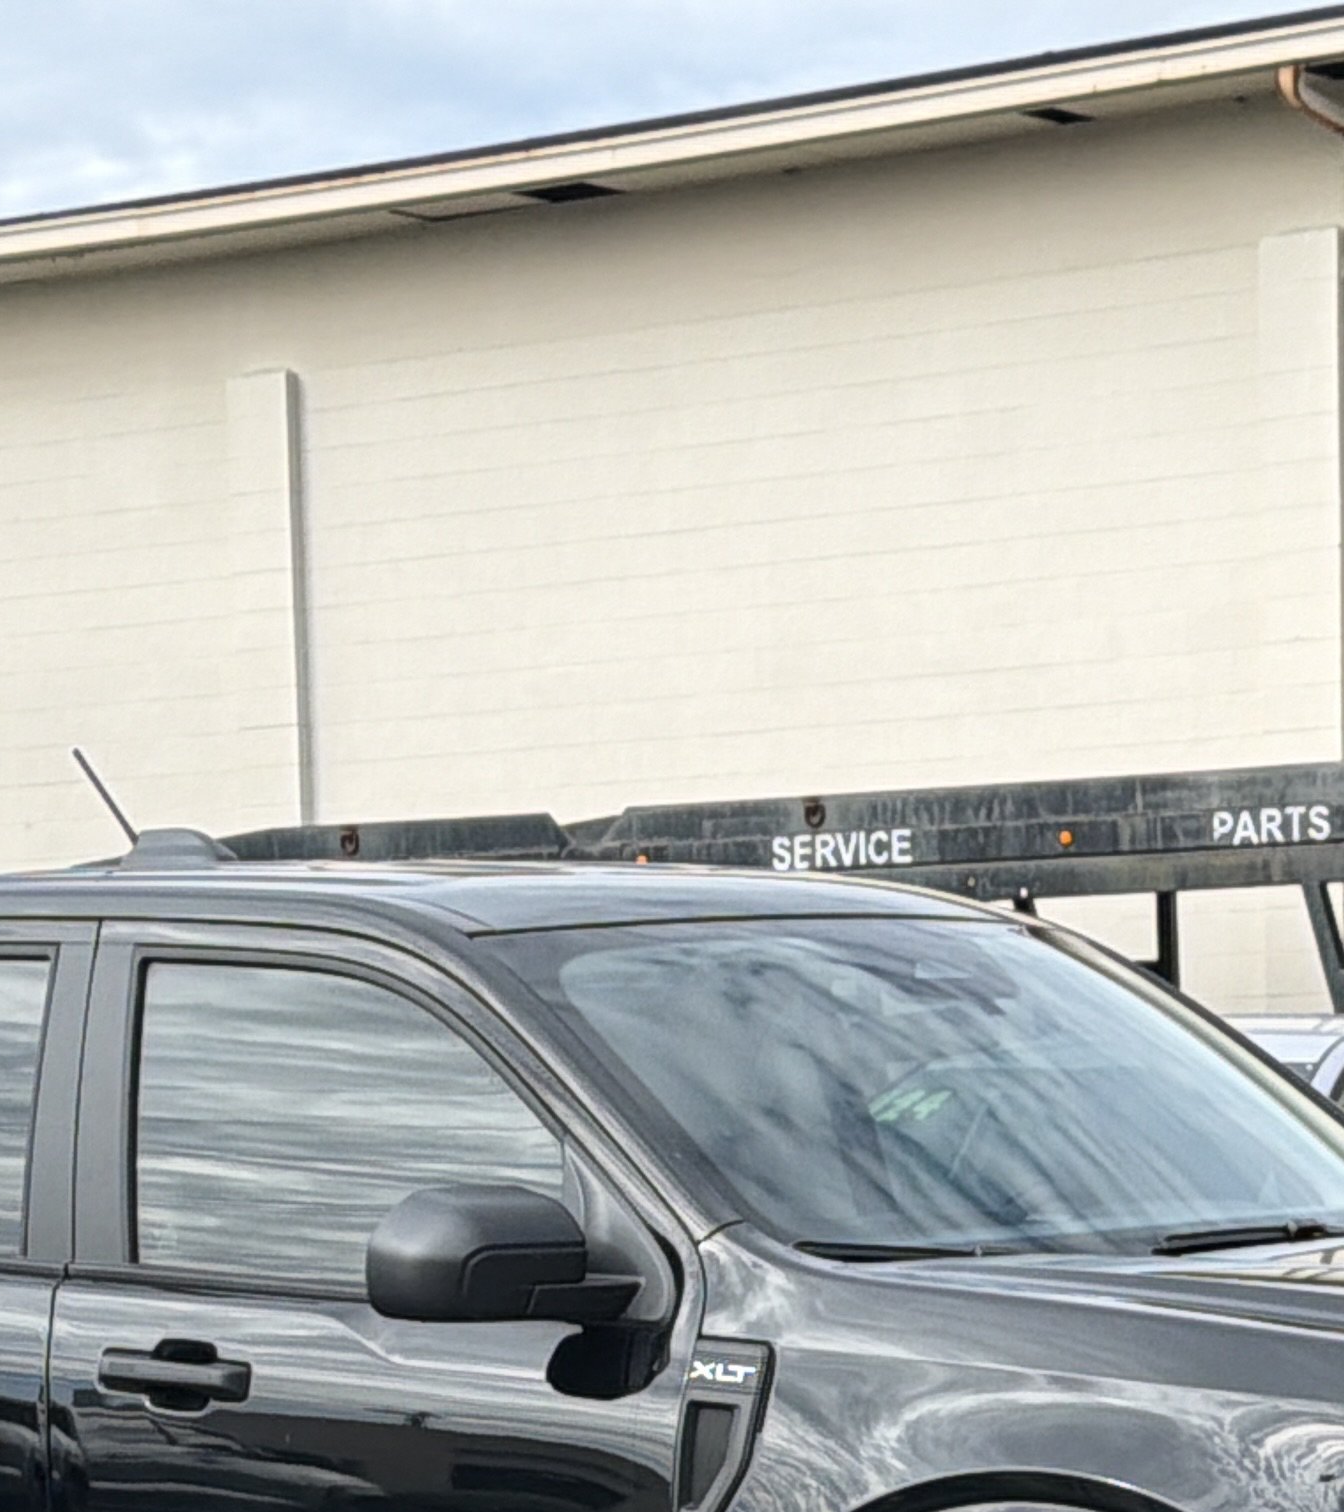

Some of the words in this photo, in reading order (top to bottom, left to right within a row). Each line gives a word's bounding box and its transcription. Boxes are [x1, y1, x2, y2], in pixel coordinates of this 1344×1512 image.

[1212, 805, 1332, 846] PARTS
[772, 828, 913, 871] SERVICE
[689, 1359, 757, 1384] XLT
